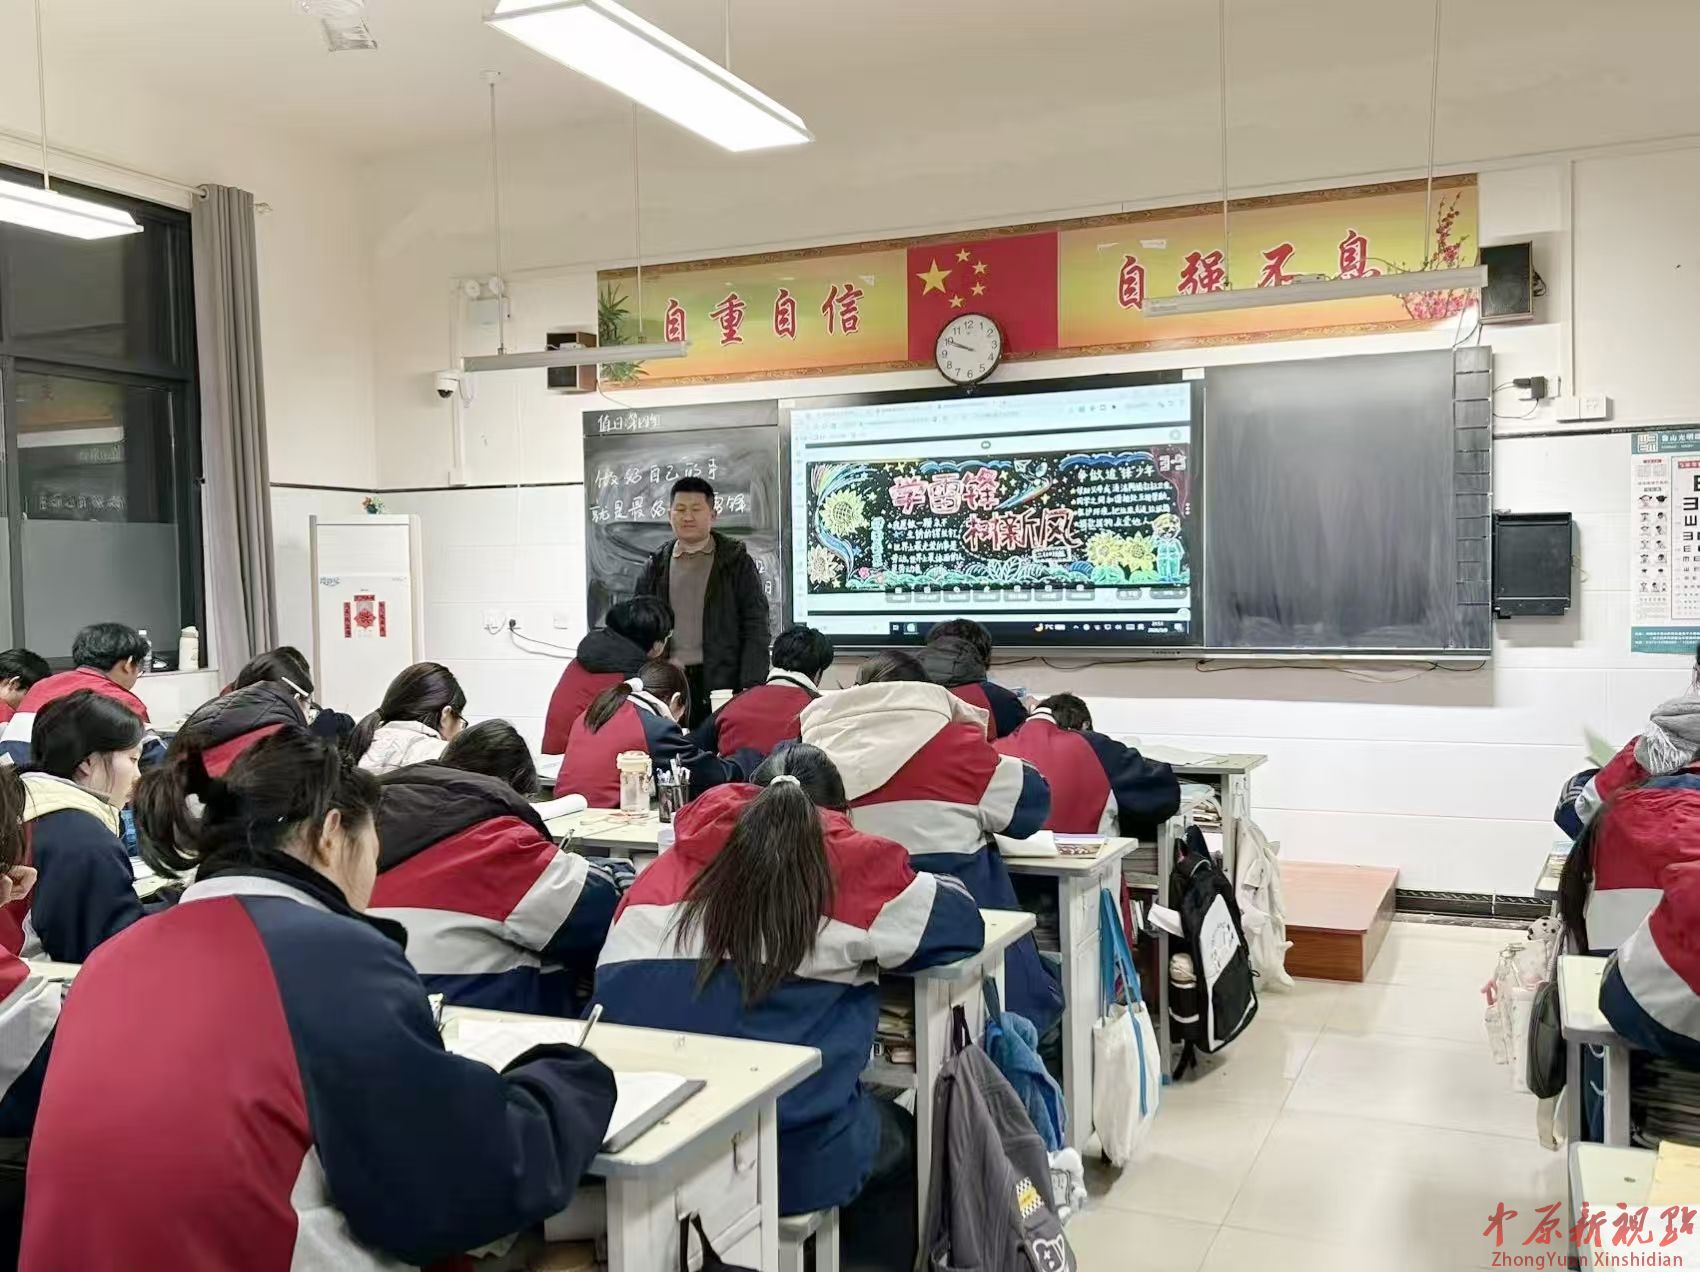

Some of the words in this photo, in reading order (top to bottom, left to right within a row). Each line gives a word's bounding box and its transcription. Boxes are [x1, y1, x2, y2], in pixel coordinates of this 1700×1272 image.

[1118, 228, 1381, 311] 自强不息
[664, 282, 866, 347] 自重自信
[963, 320, 974, 329] 12
[979, 321, 984, 330] 1
[953, 327, 961, 335] 11
[986, 328, 994, 337] 2
[945, 336, 954, 346] 10
[991, 340, 998, 349] 3
[941, 350, 948, 358] 9
[987, 352, 994, 361] 4
[946, 360, 953, 369] 8
[979, 363, 986, 373] 5
[955, 367, 961, 377] 7
[967, 369, 974, 379] 6
[595, 458, 719, 489] 做好自己的事
[889, 467, 1000, 515] 学雷锋
